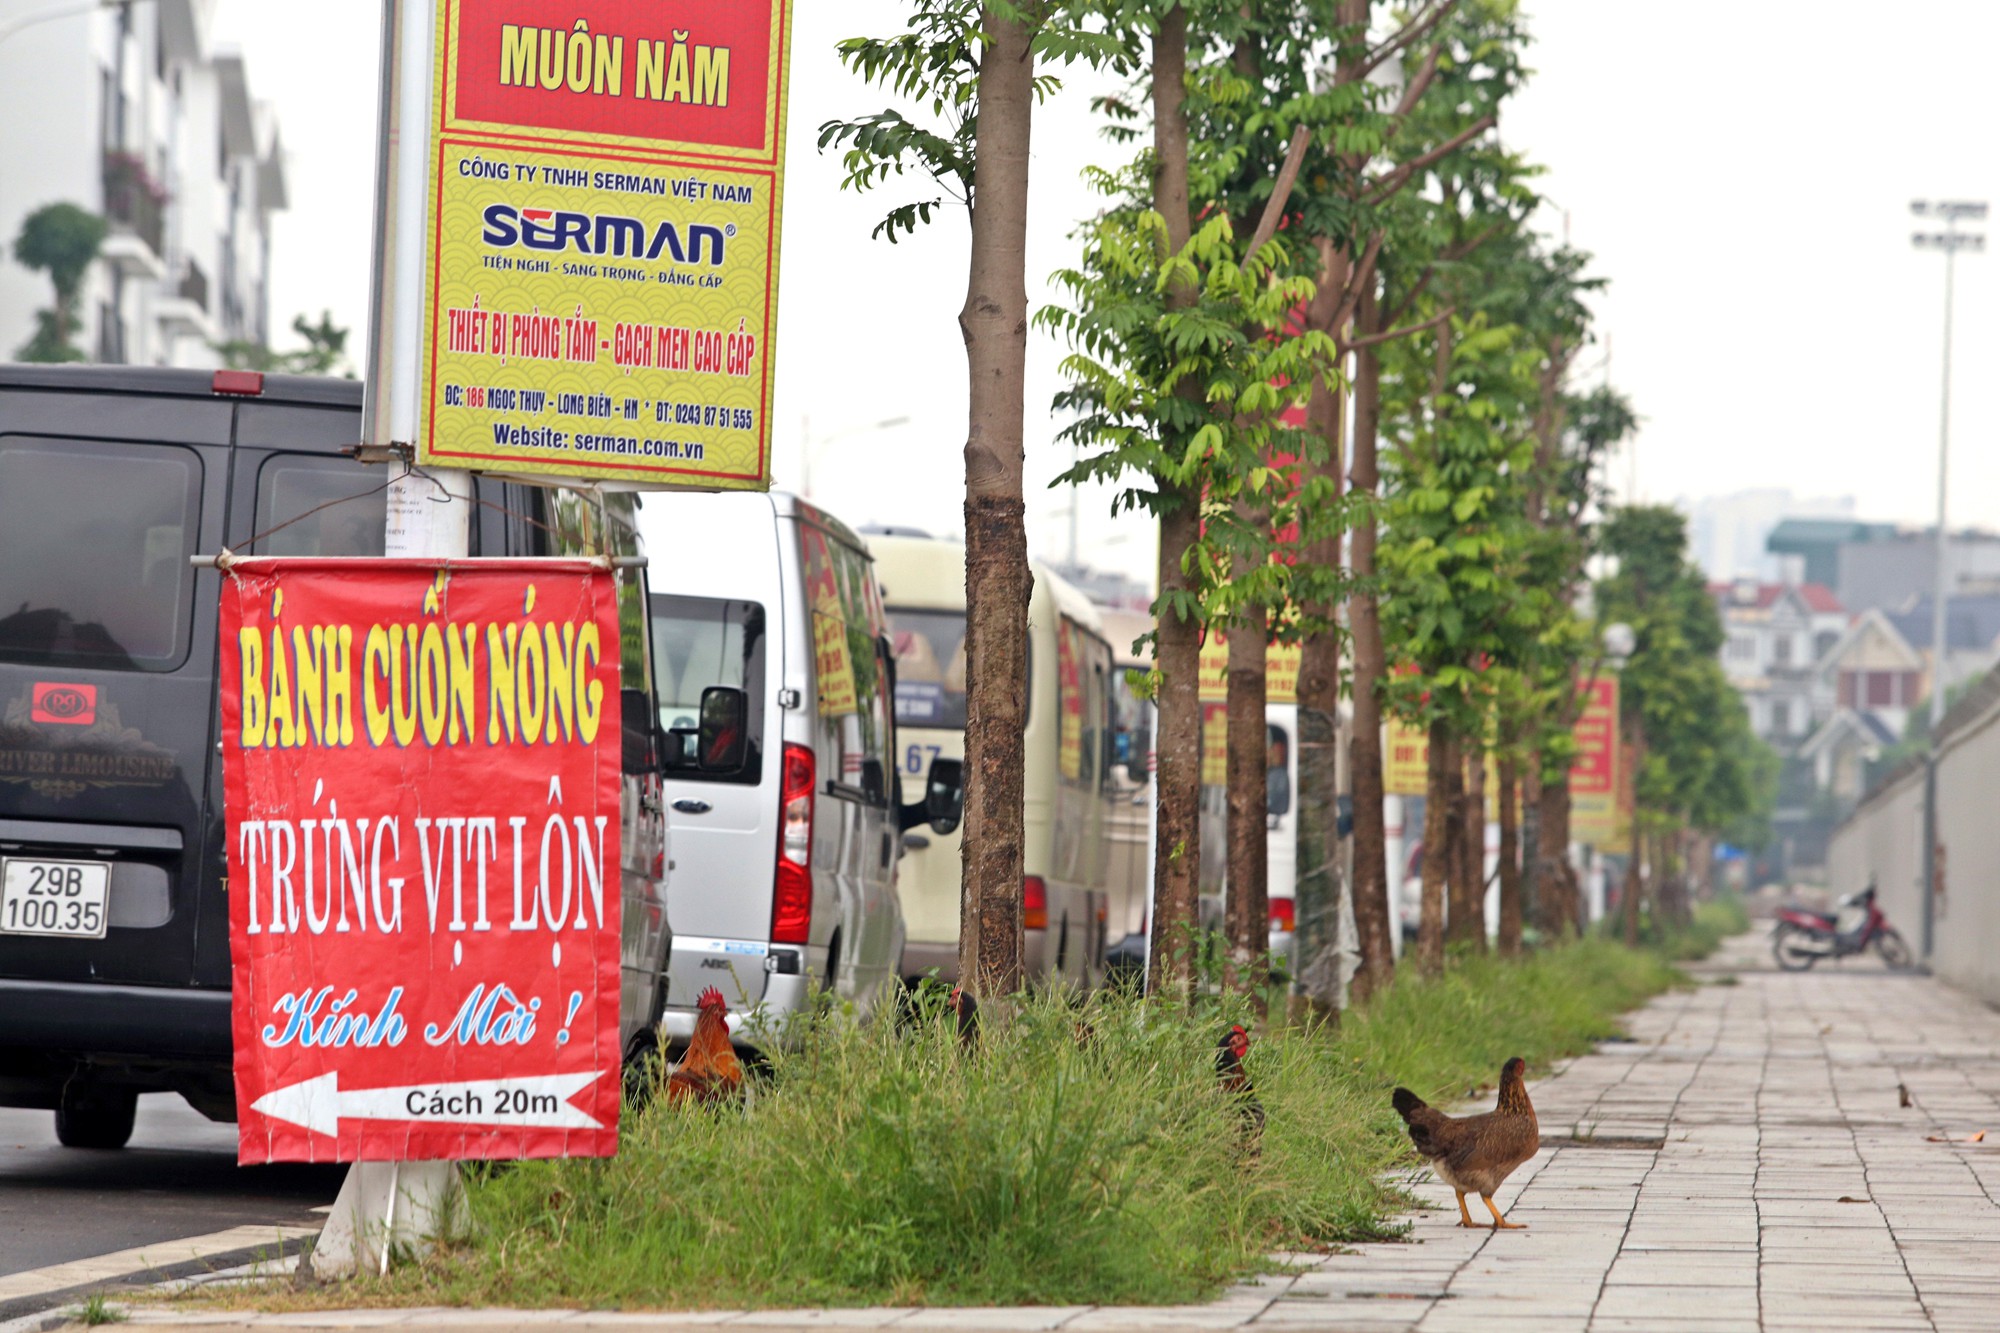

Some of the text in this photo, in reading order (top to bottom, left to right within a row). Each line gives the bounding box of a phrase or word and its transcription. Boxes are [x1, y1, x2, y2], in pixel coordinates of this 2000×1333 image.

[500, 18, 730, 107] MUÔN NĂM
[459, 156, 752, 203] CÔNG TY TNHH SERMAN VIỆT NAM
[482, 254, 513, 271] TIỆN
[517, 259, 550, 273] NGHI
[562, 262, 597, 277] SANG
[602, 266, 645, 281] TRỌNG
[698, 273, 723, 288] CẤP
[448, 294, 488, 354] THIẾT
[491, 312, 507, 365] BỊ
[511, 306, 560, 360] PHÒNG
[565, 304, 597, 363] TẮM
[614, 322, 653, 375] GẠCH
[656, 326, 690, 370] MEN
[694, 329, 722, 373] CAO
[726, 317, 755, 376] CẤP
[445, 385, 463, 406] ĐC:
[466, 386, 485, 408] 186
[487, 387, 516, 414] NGỌC
[519, 390, 545, 416] THỤY
[557, 393, 584, 415] LONG
[624, 398, 638, 420] HN
[656, 401, 672, 423] ĐT:
[675, 403, 700, 426] 0243
[704, 406, 716, 427] 87
[719, 407, 730, 428] 51
[733, 409, 752, 430] 555
[493, 423, 704, 460] Website: serman.com.vn
[239, 570, 603, 749] BÁNH CUỐN NÓNG
[60, 753, 175, 779] LIMOUSINE
[28, 866, 83, 897] 29B
[240, 774, 608, 968] TRỨNG VỊT LỘN
[8, 898, 101, 932] 100.35
[262, 984, 408, 1048] Kính
[424, 982, 542, 1047] Mời
[405, 1089, 558, 1116] Cách 20m
